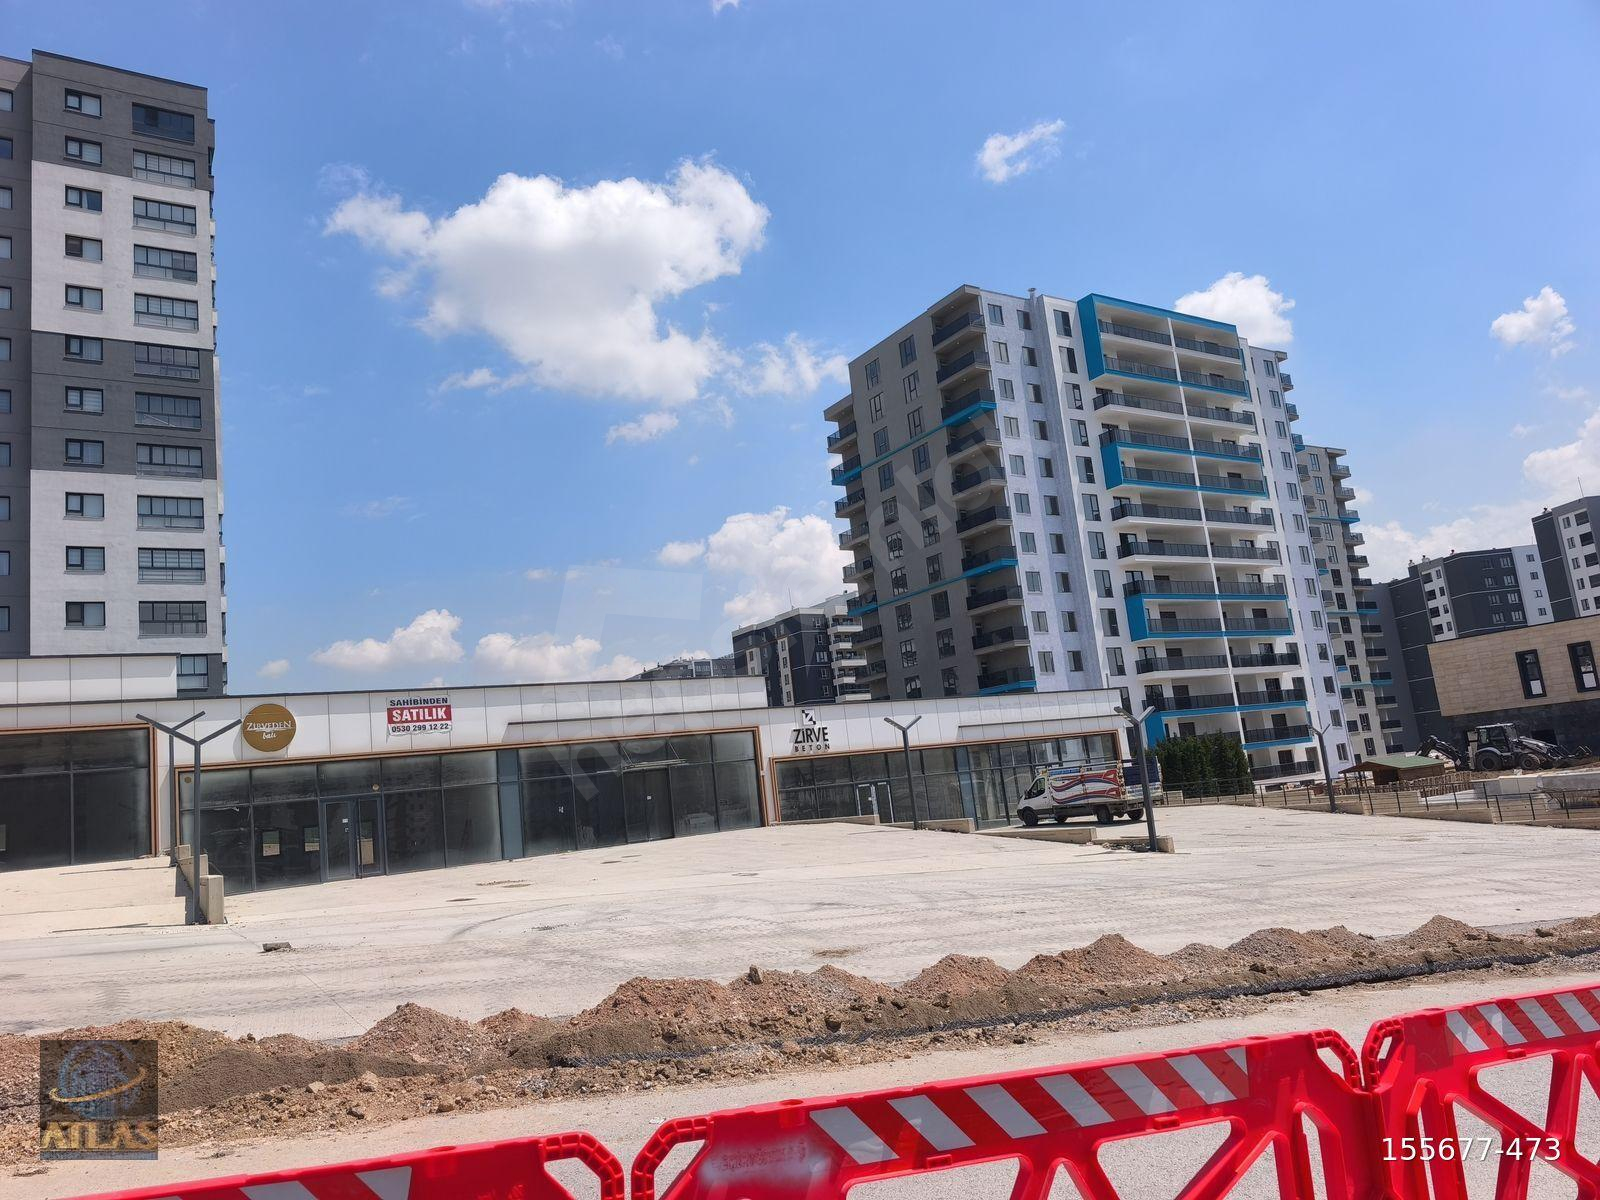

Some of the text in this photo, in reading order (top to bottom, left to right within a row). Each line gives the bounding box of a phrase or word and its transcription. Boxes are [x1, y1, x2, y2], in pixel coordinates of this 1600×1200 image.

[392, 707, 447, 722] SATILIK
[391, 722, 449, 733] 0530 299 12 22
[794, 744, 830, 752] BETON
